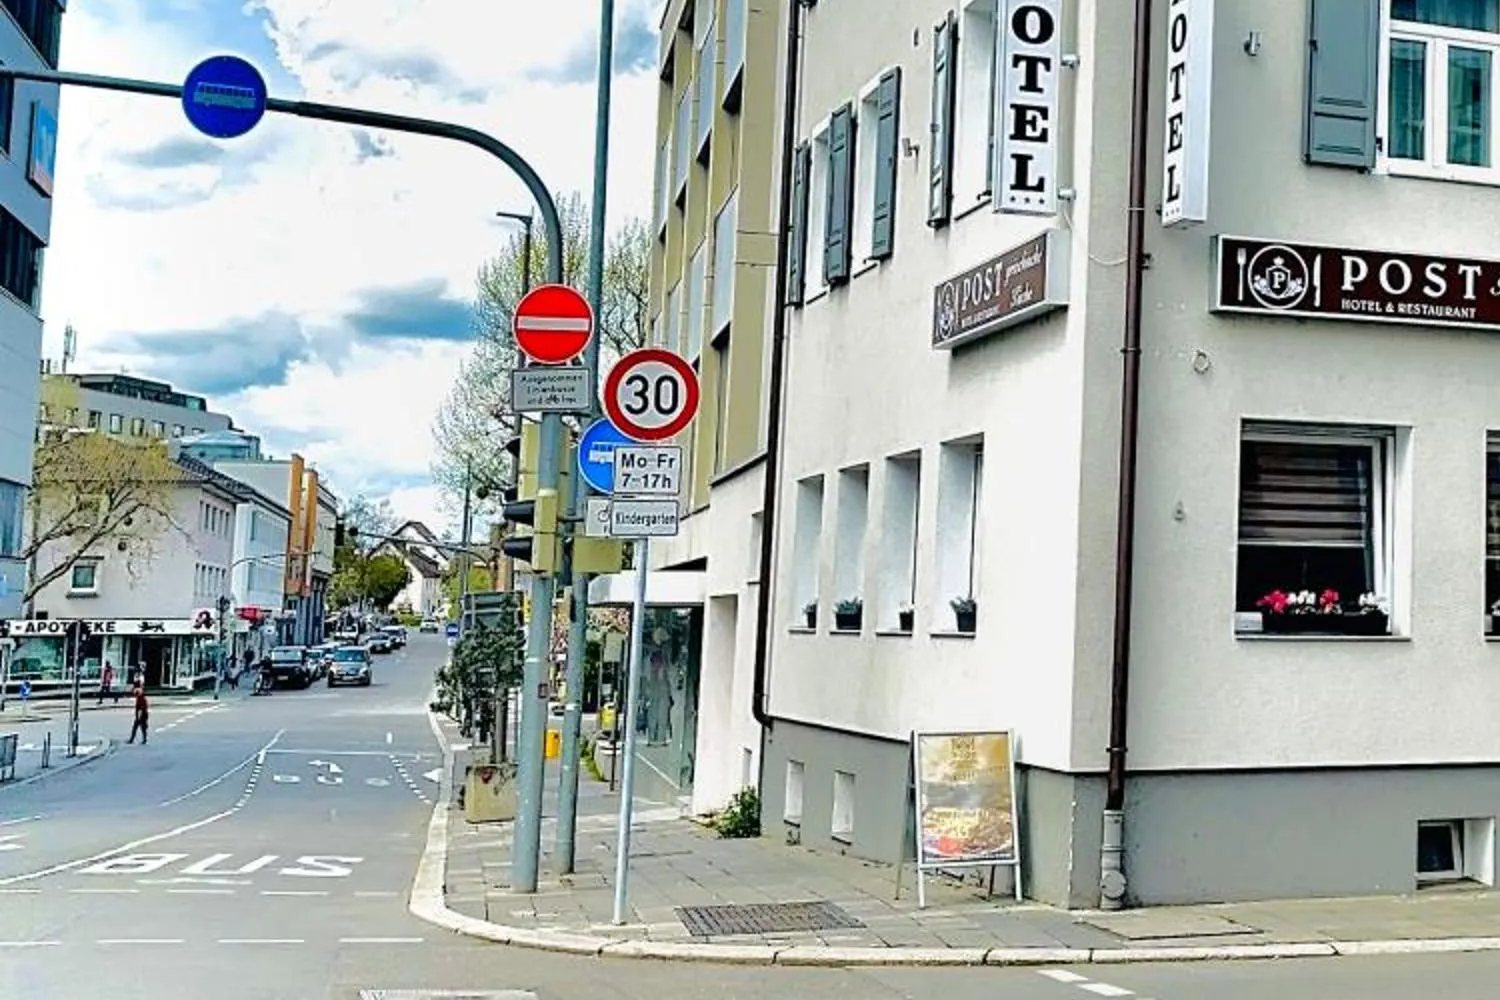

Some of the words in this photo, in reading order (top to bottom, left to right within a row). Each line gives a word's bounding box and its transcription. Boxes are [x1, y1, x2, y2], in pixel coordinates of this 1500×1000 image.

[960, 260, 1003, 311] POST
[1272, 271, 1287, 290] P
[1341, 255, 1482, 300] POST
[1341, 298, 1382, 313] HOTEL
[1385, 301, 1395, 313] &
[1397, 302, 1477, 319] RESTAURANT
[625, 374, 679, 415] 30
[616, 511, 677, 527] Kindergarten
[73, 853, 364, 877] BUS
